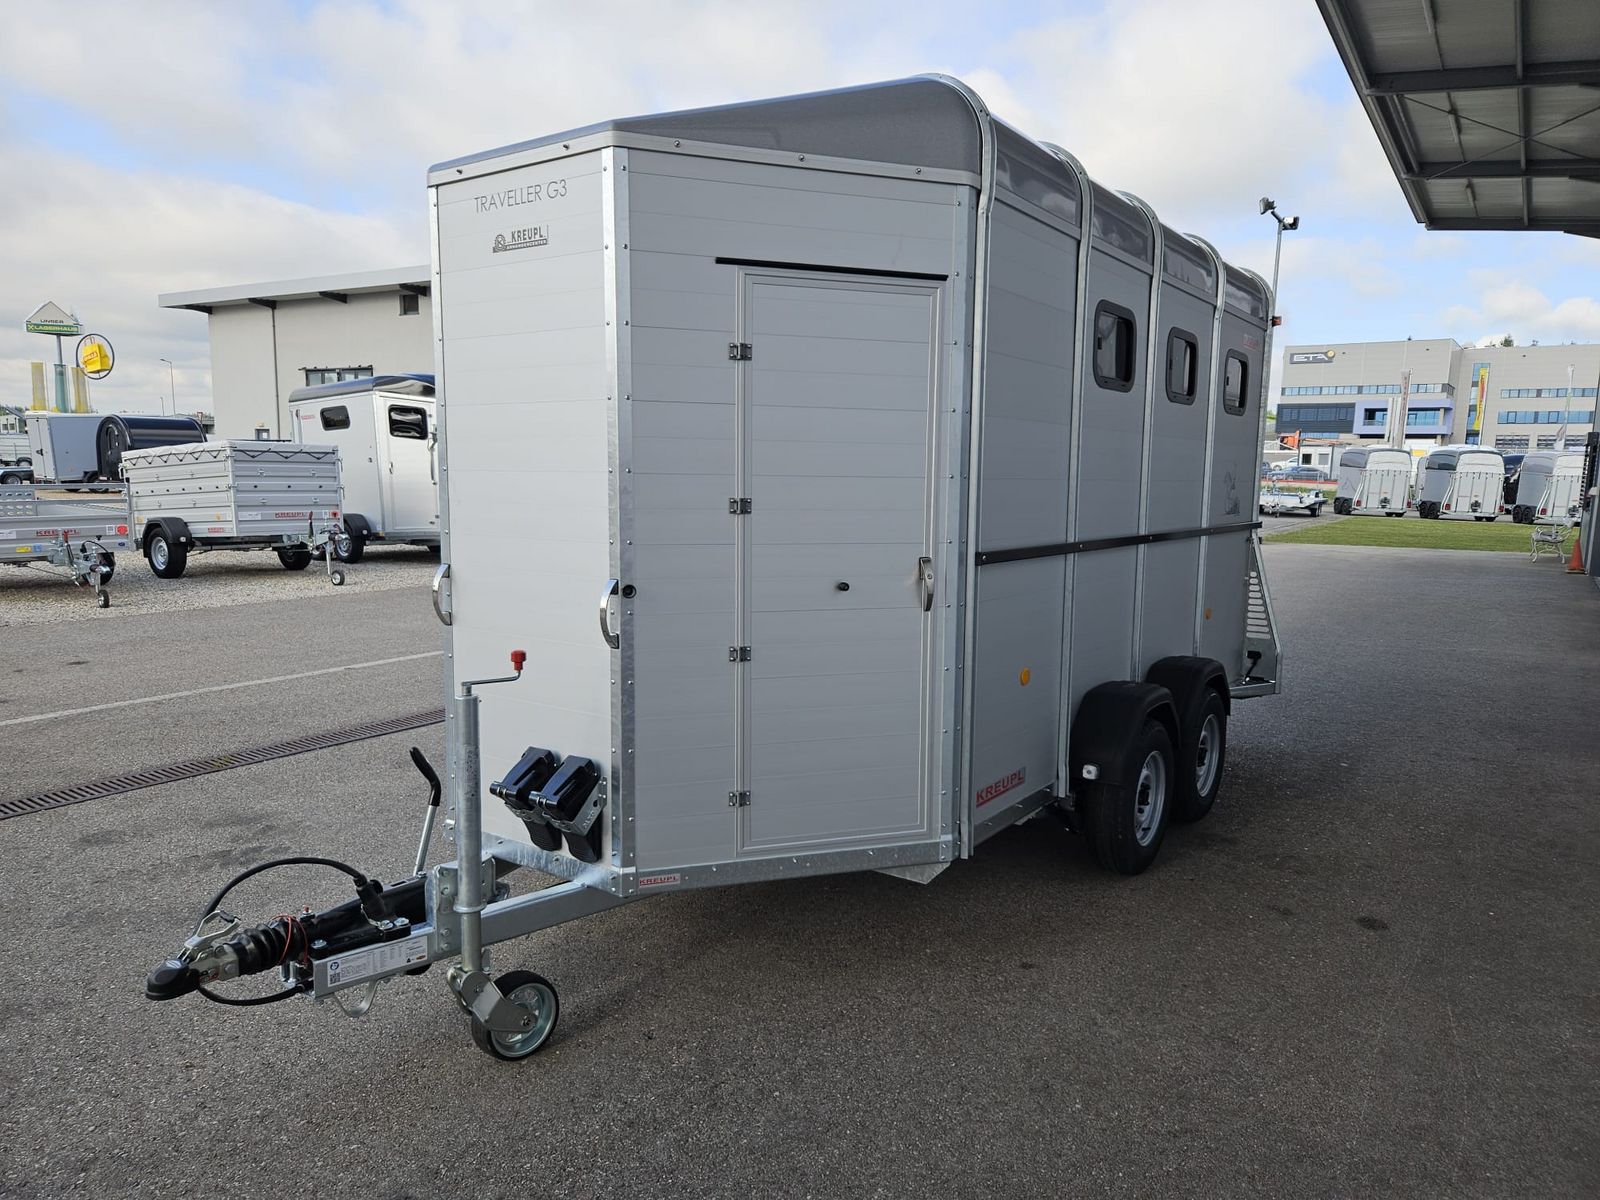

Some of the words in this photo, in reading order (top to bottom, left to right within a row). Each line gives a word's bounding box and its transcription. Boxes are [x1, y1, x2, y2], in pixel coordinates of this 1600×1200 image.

[474, 184, 542, 213] TRAVELLER
[546, 179, 568, 199] G3
[511, 226, 543, 243] KREUPL
[1293, 353, 1329, 362] ETA
[976, 770, 1025, 803] KREUPL
